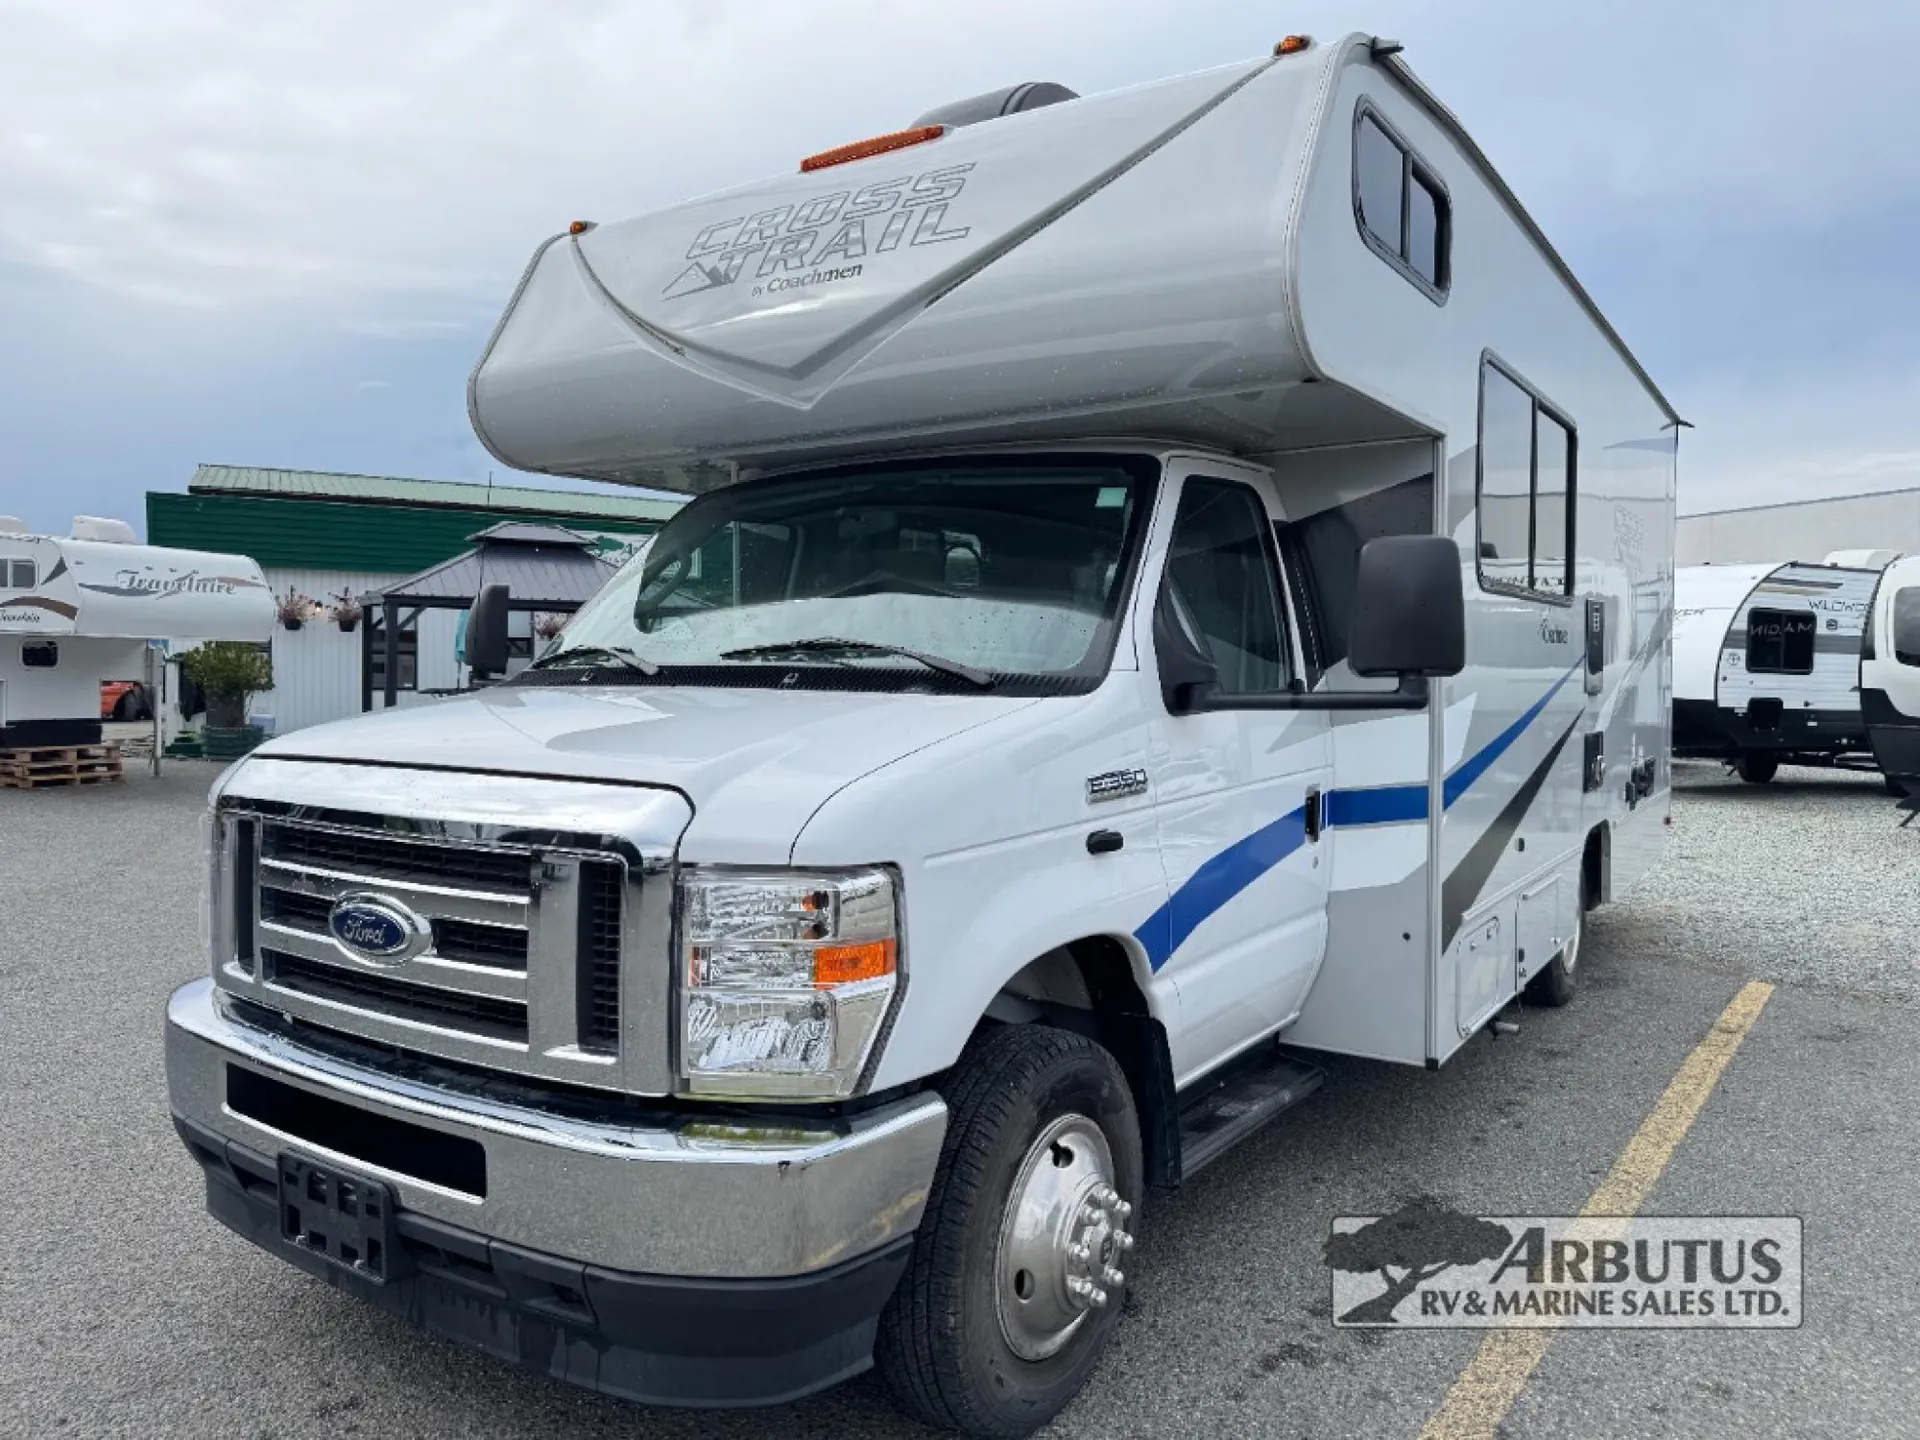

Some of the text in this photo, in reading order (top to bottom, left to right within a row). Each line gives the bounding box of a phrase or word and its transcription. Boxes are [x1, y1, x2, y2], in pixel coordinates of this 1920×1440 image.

[686, 161, 977, 260] CROSS
[718, 202, 971, 284] TRAIL
[767, 264, 863, 292] Coachmen
[343, 912, 387, 944] Ford
